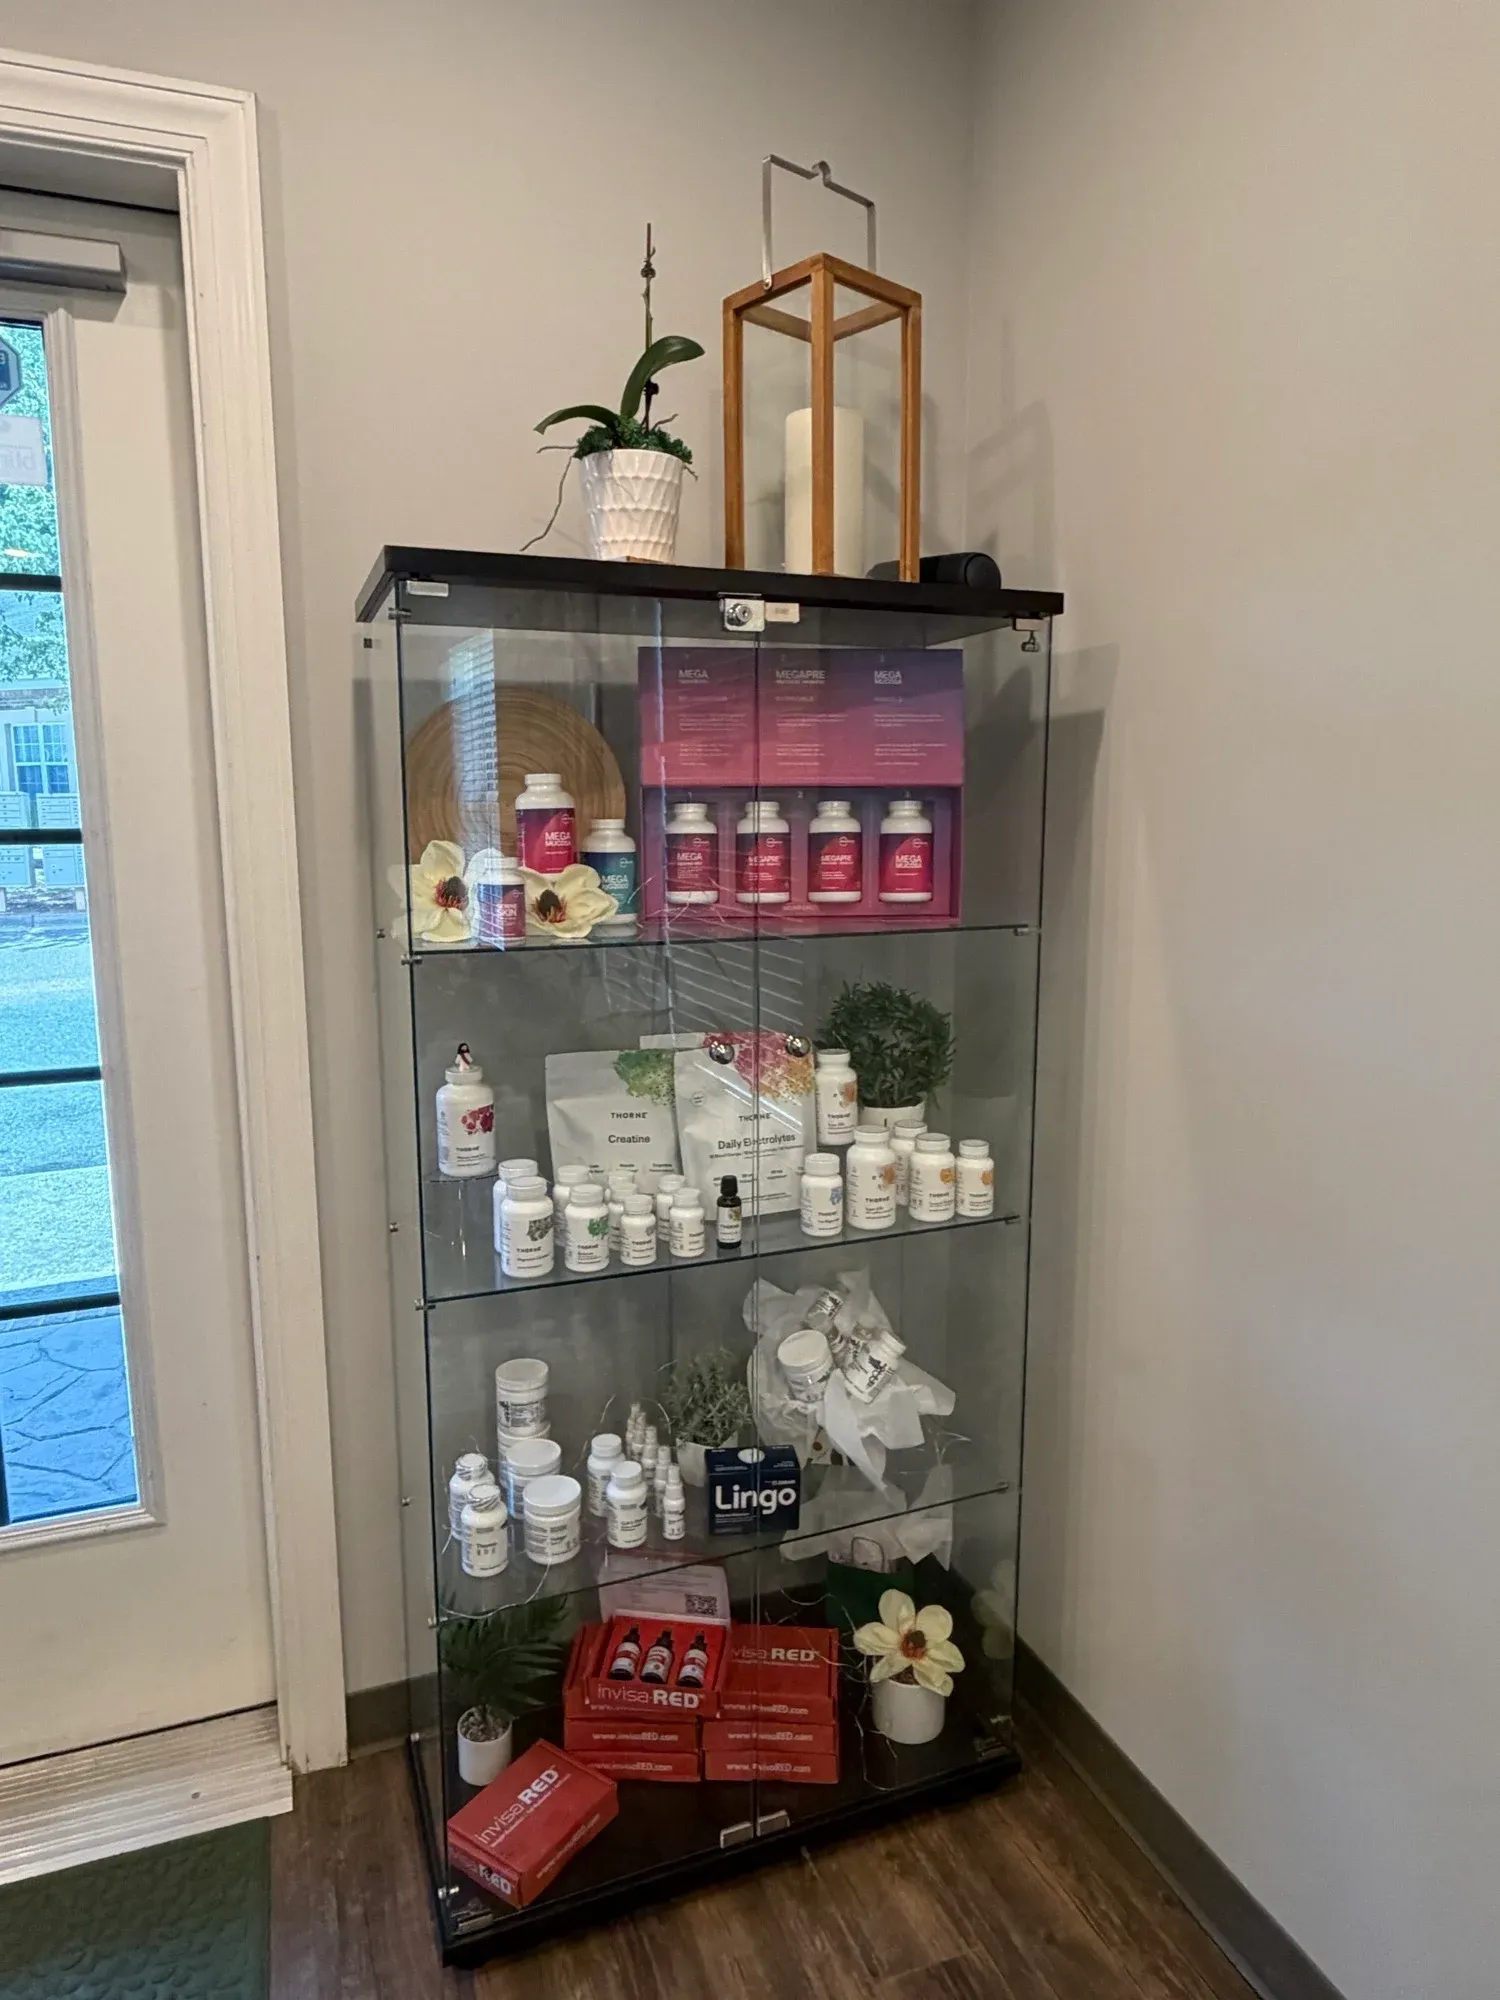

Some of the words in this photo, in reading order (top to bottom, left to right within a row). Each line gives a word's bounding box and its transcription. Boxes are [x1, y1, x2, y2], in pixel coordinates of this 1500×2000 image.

[678, 670, 709, 679] MEGA
[775, 670, 827, 679] MEGAPRE
[874, 670, 902, 678] MEGA
[545, 832, 572, 840] MEGA
[677, 852, 703, 860] MEGA
[602, 875, 629, 883] MEGA
[608, 1134, 651, 1144] Creatine
[718, 1140, 742, 1150] Daily
[715, 1484, 797, 1515] Lingo
